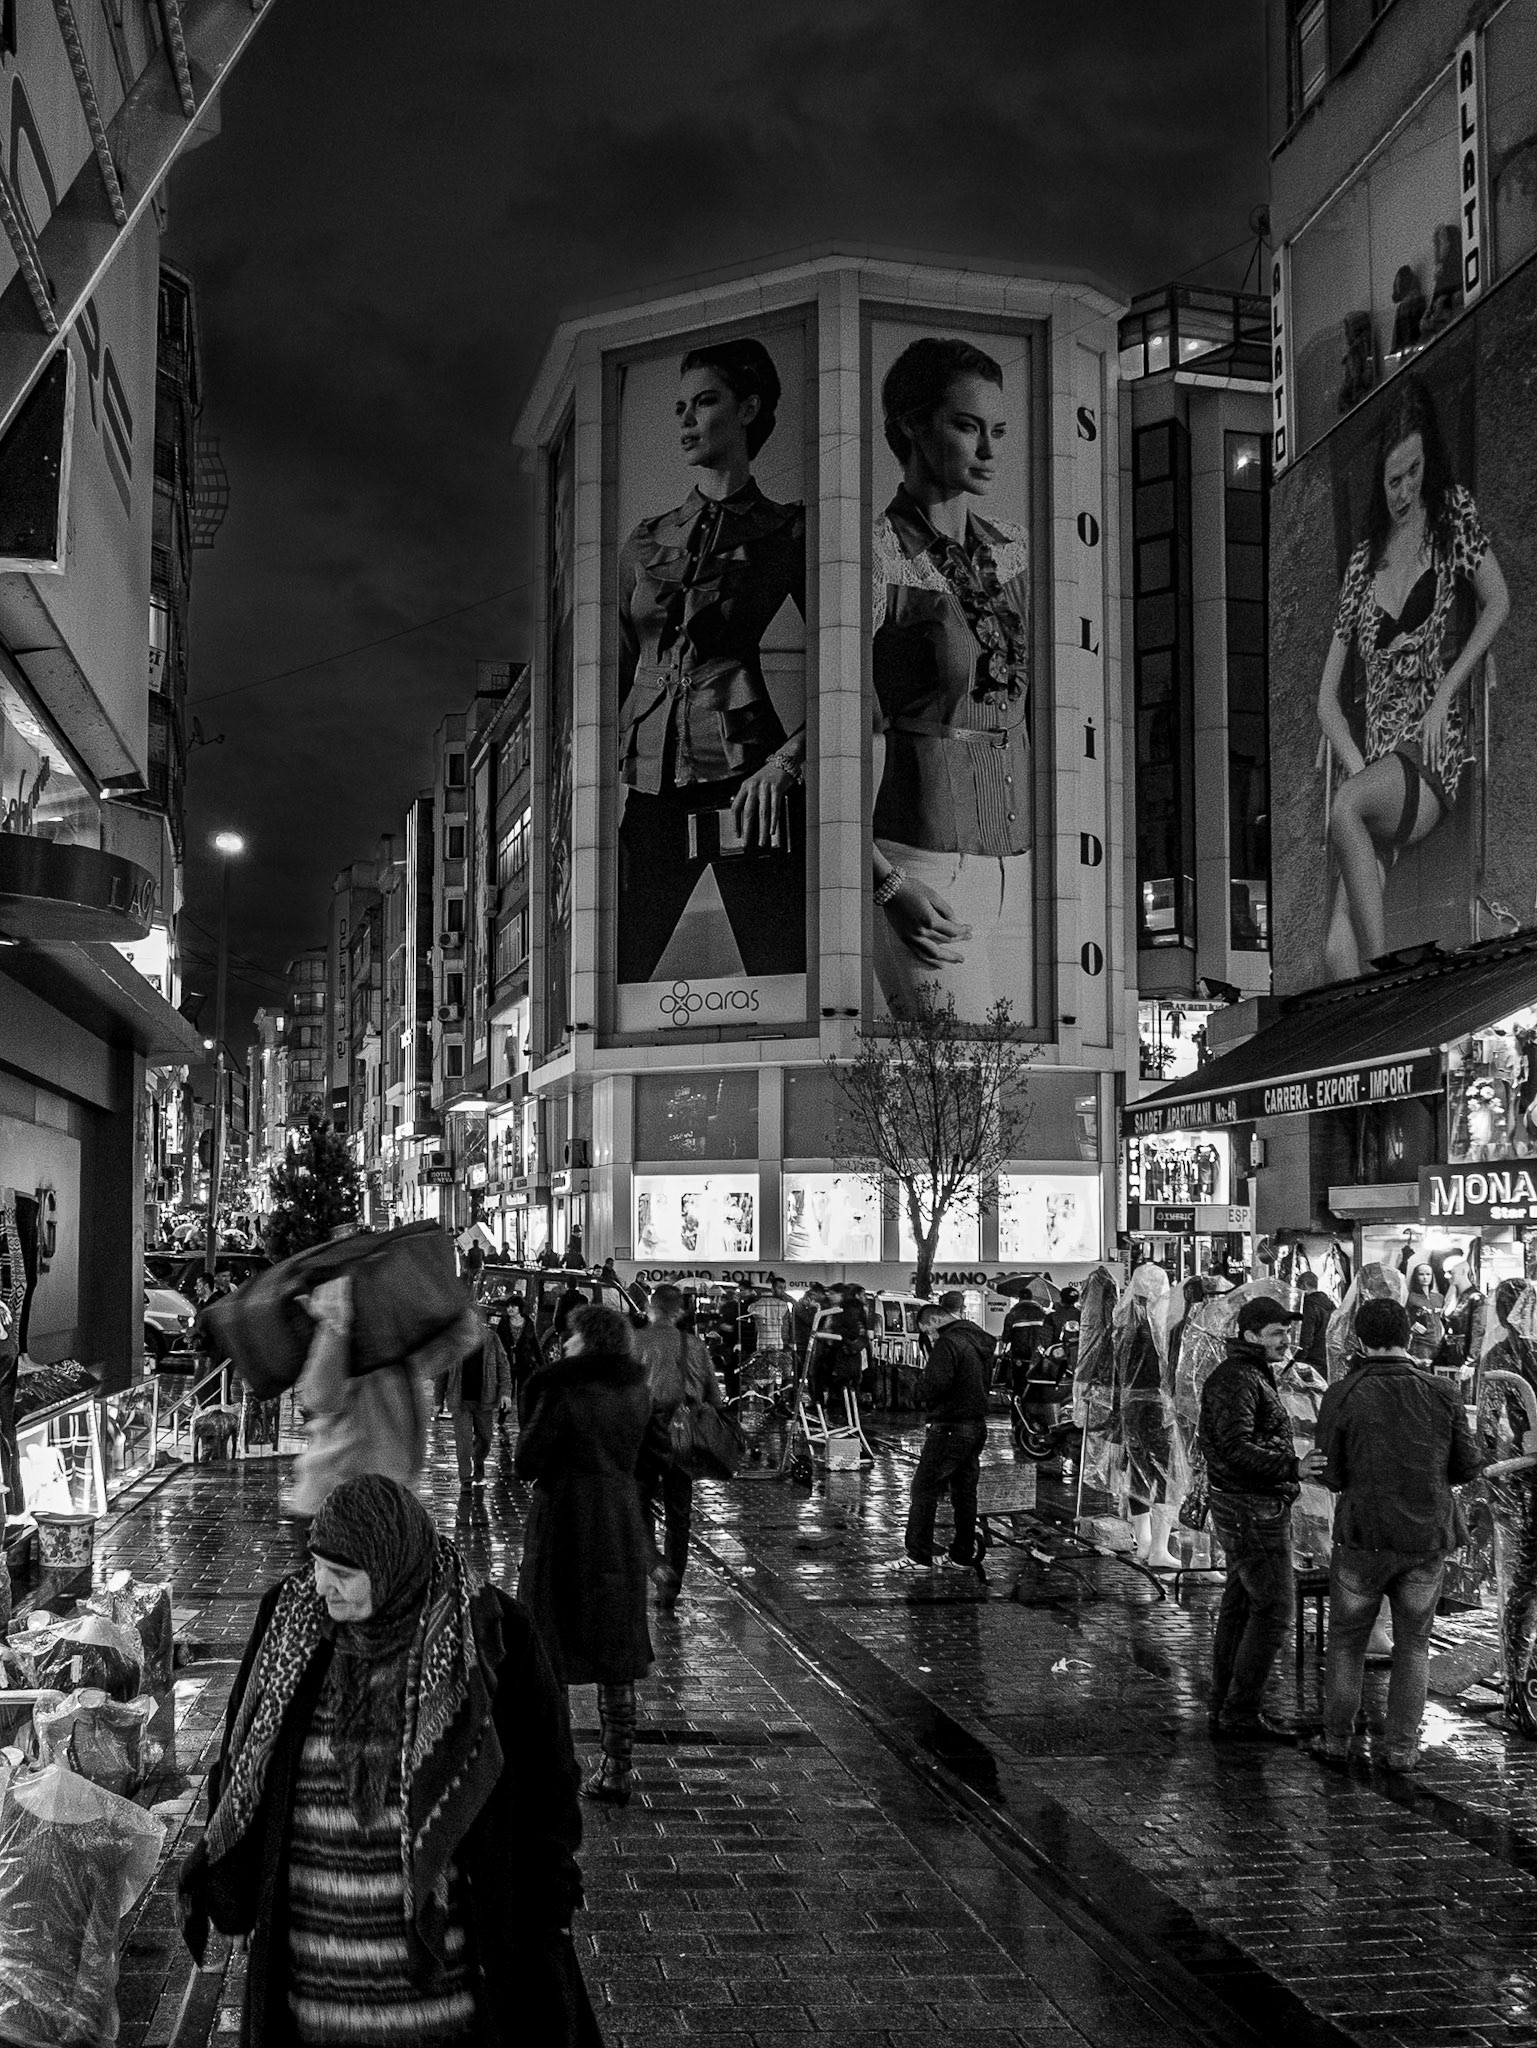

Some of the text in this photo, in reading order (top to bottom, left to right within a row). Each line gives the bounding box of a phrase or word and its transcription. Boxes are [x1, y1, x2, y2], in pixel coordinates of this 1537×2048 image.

[1460, 49, 1480, 294] ALATO
[1272, 262, 1287, 463] ALATO
[705, 989, 760, 1012] aras
[1264, 1064, 1414, 1114] CARRERA EXPORT IMPORT
[1134, 1109, 1163, 1133] SAADET
[1166, 1101, 1211, 1129] APARTMANI
[1429, 1170, 1537, 1215] MONA
